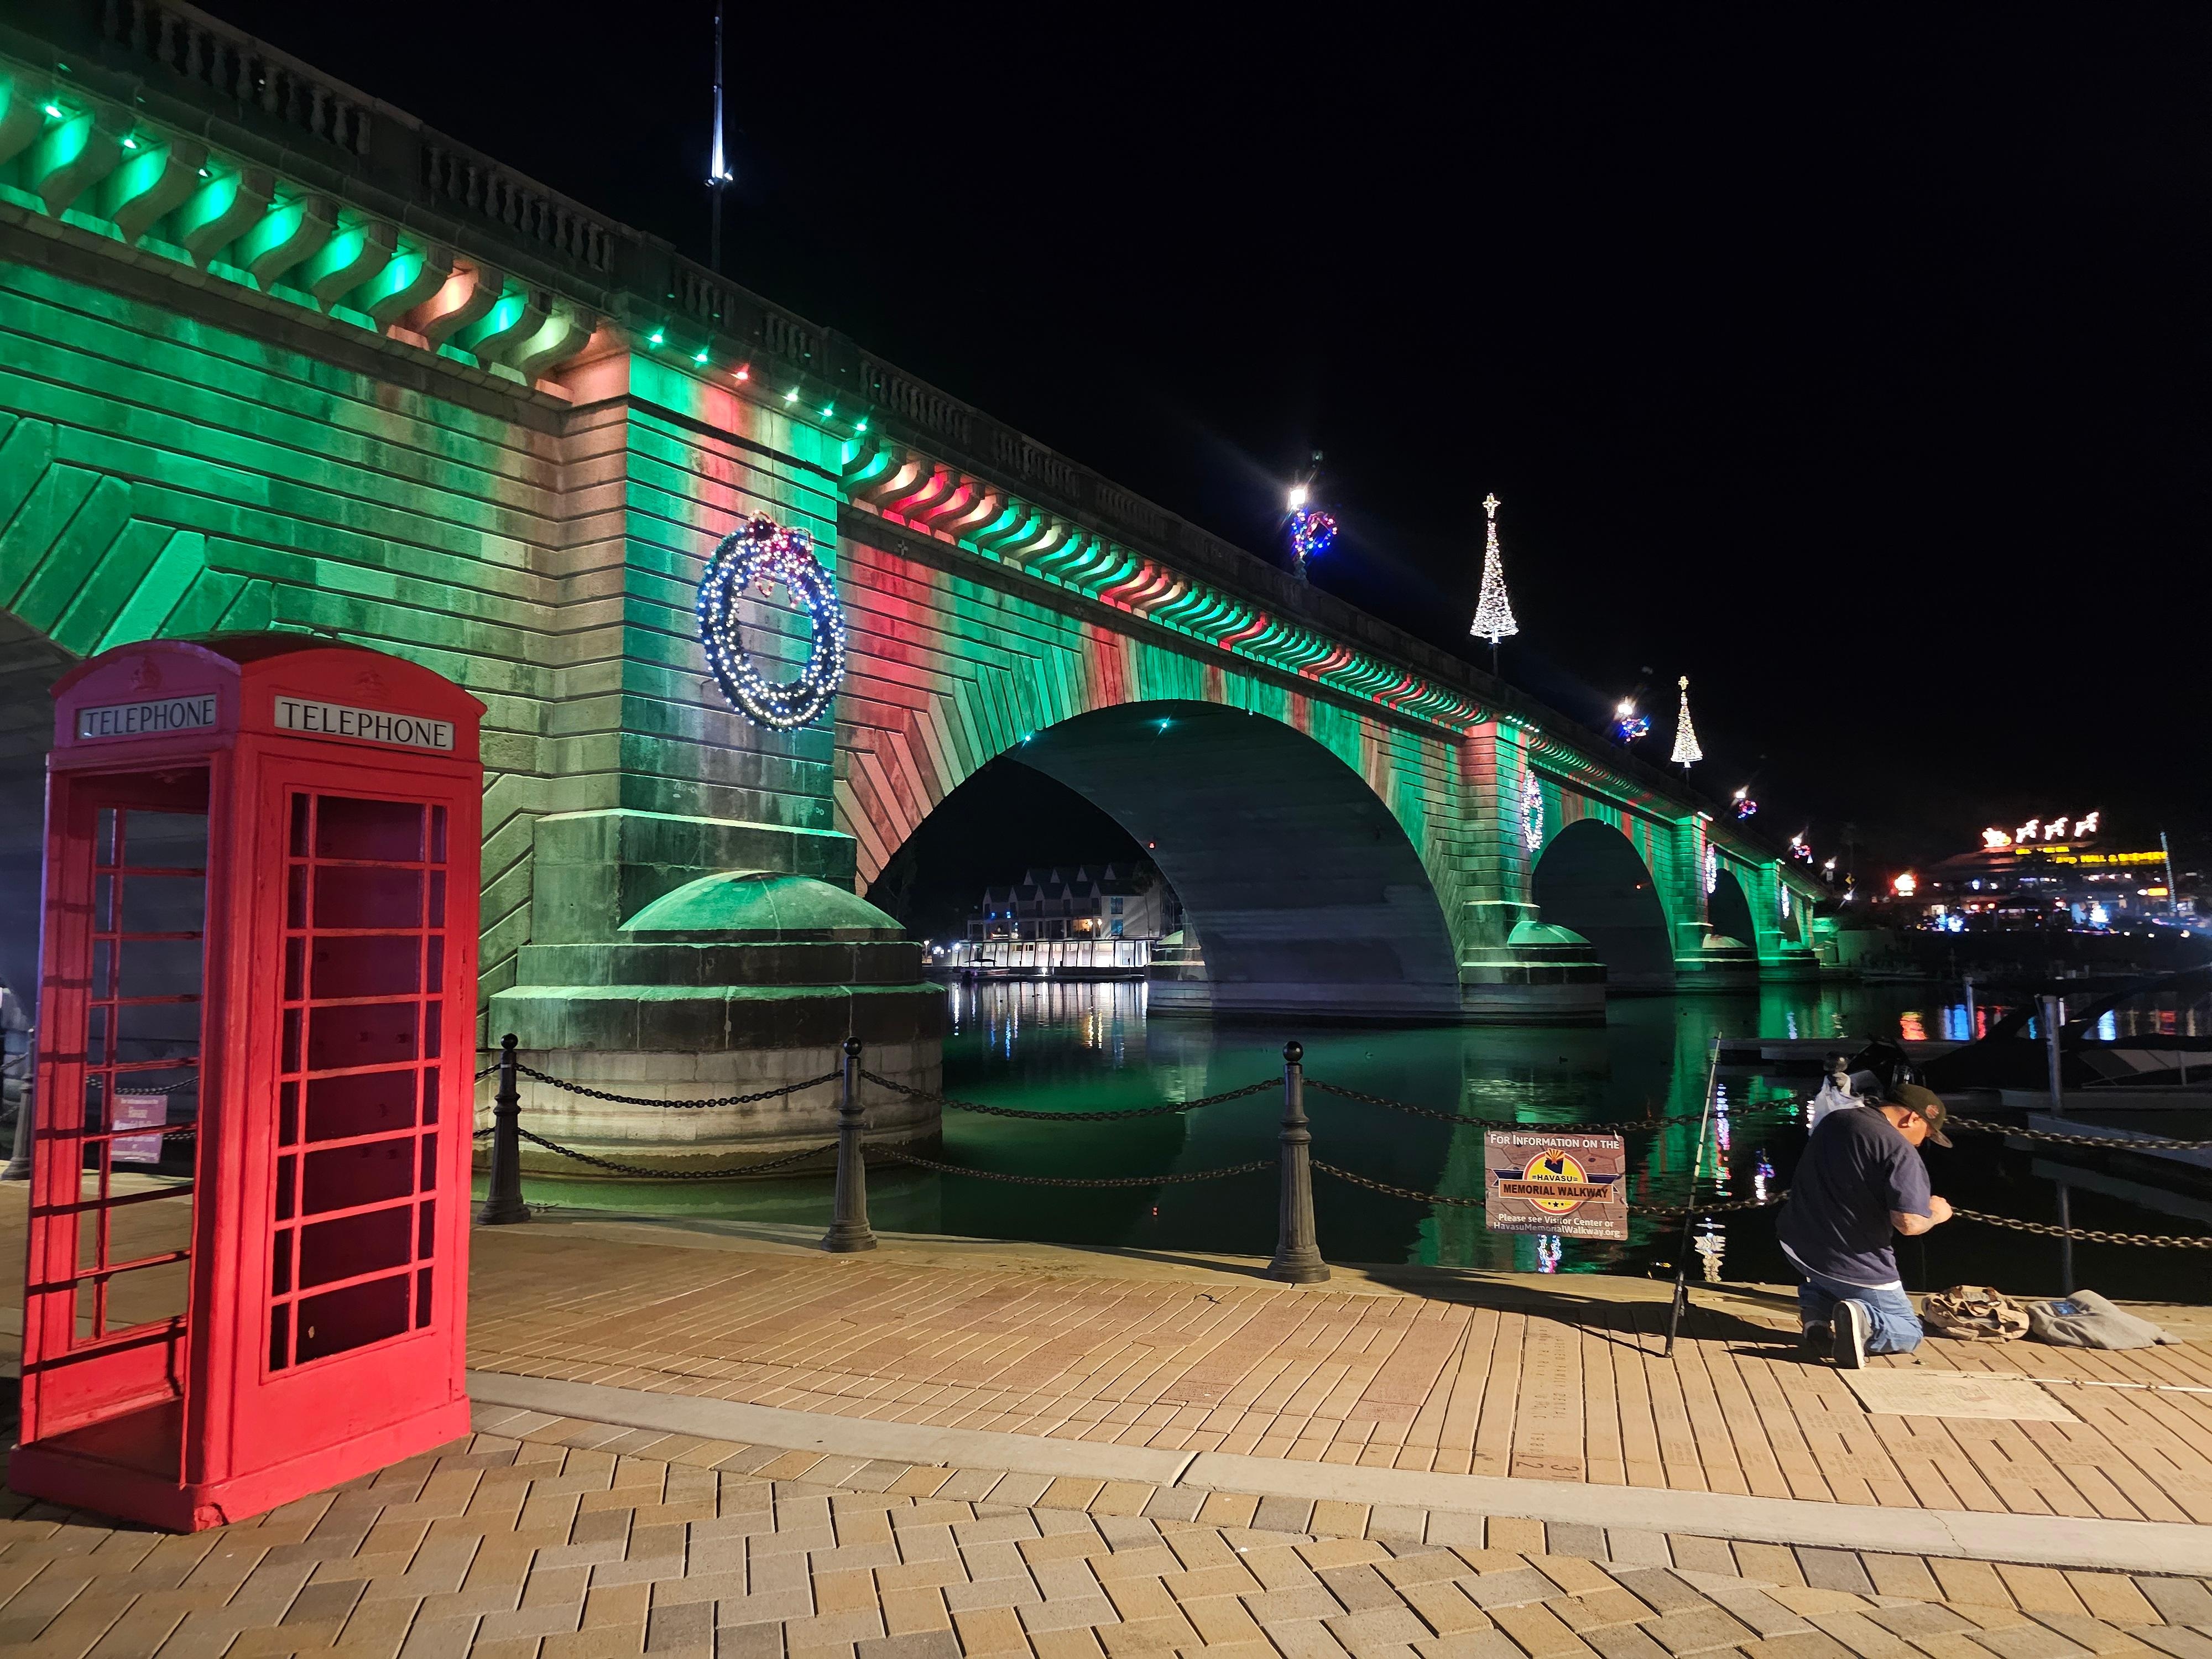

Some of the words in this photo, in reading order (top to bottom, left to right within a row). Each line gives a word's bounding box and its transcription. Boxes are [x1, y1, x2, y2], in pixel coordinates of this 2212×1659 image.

[85, 698, 215, 737] TELEPHONE
[281, 702, 448, 747] TELEPHONE
[1490, 1134, 1510, 1145] FOR
[1512, 1135, 1579, 1147] INFORMATION
[1582, 1139, 1598, 1149] ON
[1600, 1140, 1620, 1149] THE
[1503, 1183, 1555, 1196] MEMORIAL
[1557, 1186, 1608, 1198] WALKWAY
[1498, 1213, 1527, 1222] Please
[1544, 1216, 1572, 1224] Visitor
[1573, 1218, 1603, 1227] Center
[1493, 1222, 1621, 1238] HavasuMemorialWalkway.org
